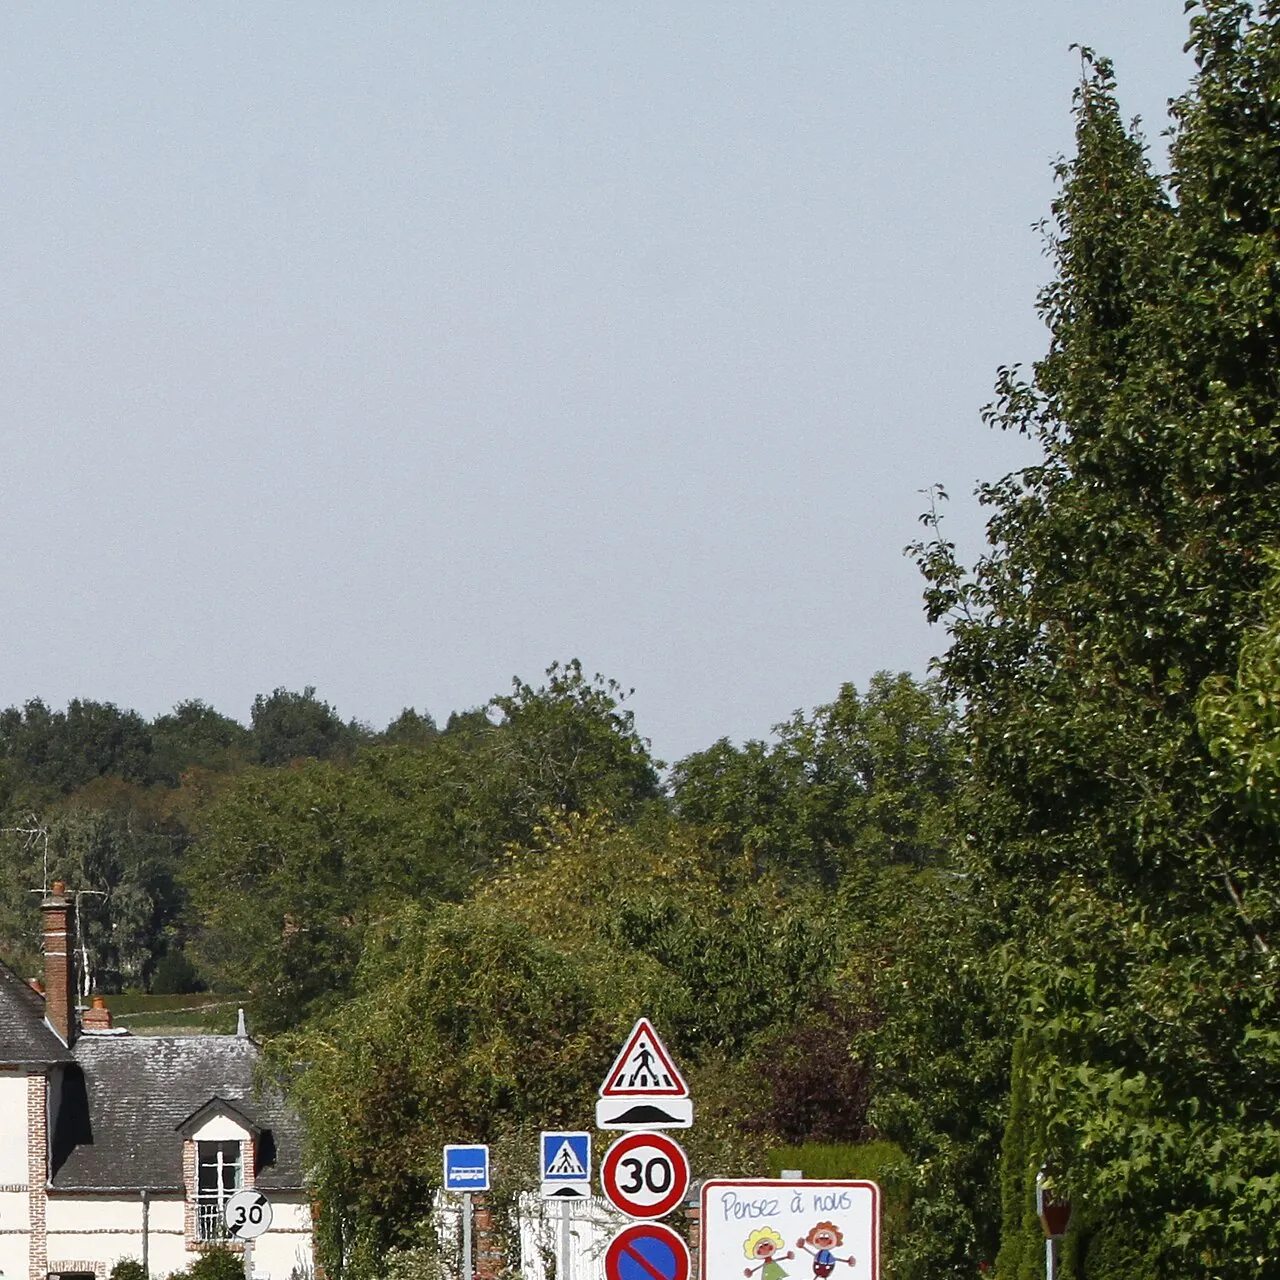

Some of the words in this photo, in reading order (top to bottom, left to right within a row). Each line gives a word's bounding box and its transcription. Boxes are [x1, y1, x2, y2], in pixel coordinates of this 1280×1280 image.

[620, 1157, 671, 1194] 30
[235, 1206, 262, 1224] 30
[721, 1191, 781, 1221] Pensez
[790, 1190, 804, 1213] à
[814, 1192, 852, 1211] nous
